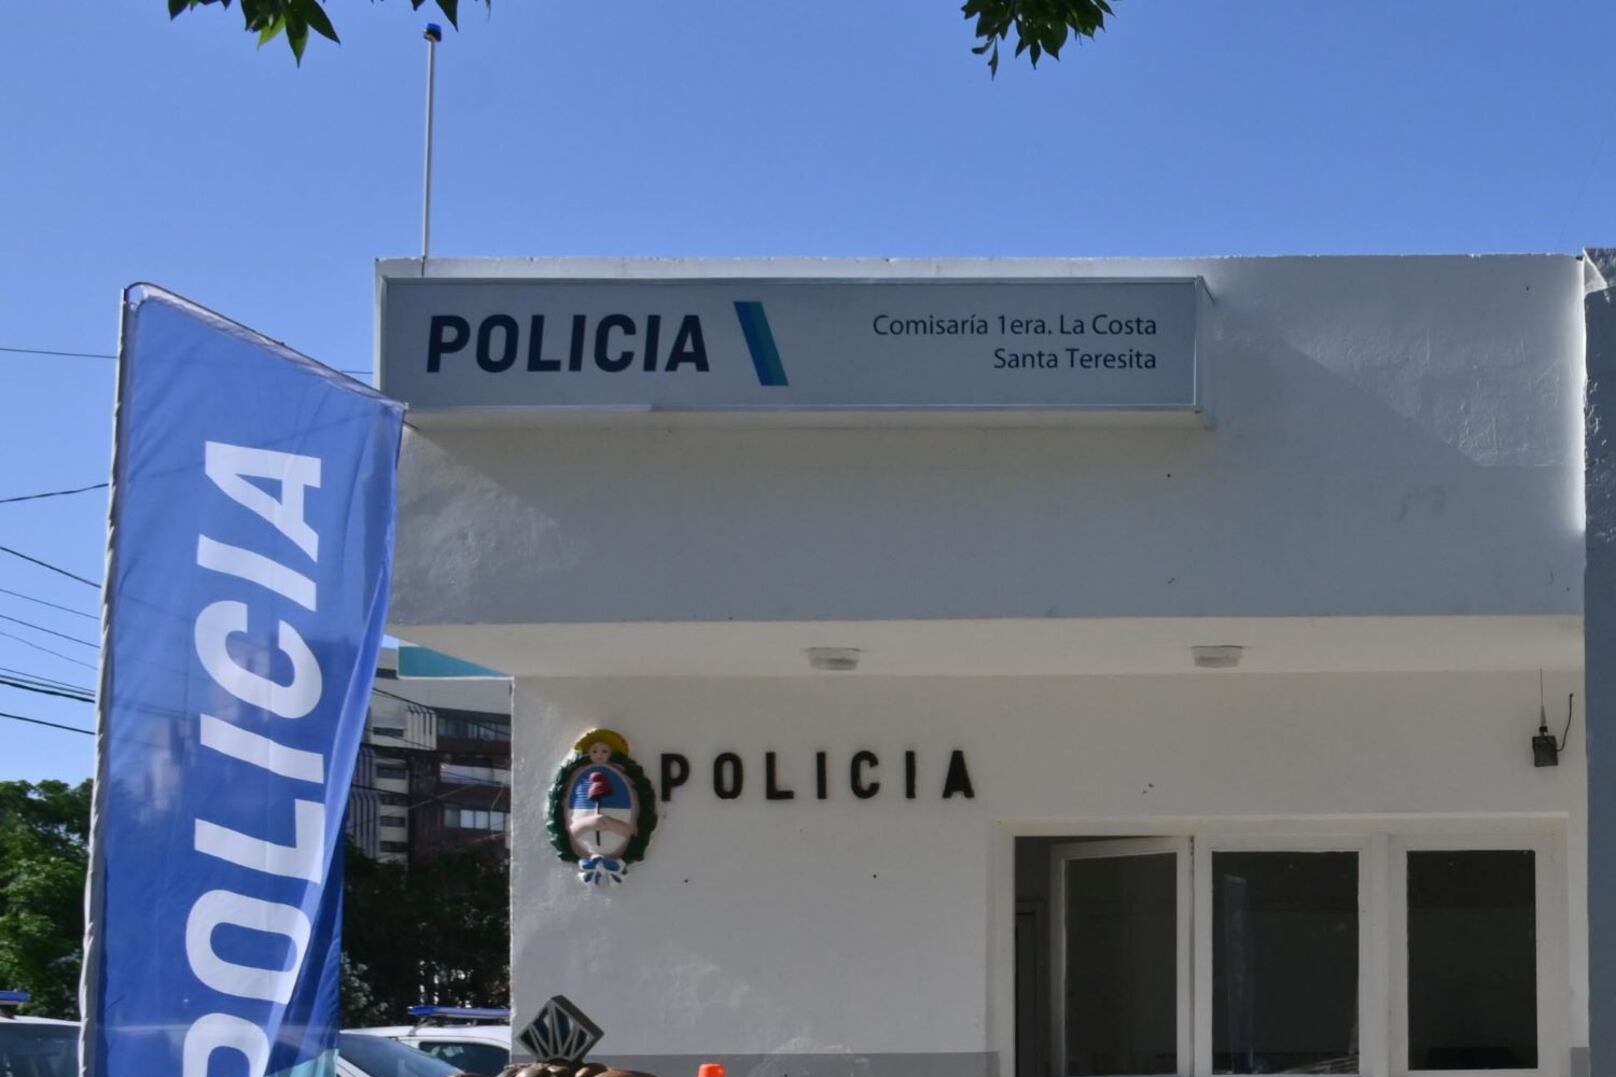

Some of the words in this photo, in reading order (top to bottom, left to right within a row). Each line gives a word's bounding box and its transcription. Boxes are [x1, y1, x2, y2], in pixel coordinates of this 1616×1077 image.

[426, 313, 710, 374] POLICIA
[873, 314, 988, 336] Comisaría
[997, 314, 1052, 336] 1era.
[1059, 314, 1085, 335] La
[1092, 314, 1157, 336] Costa
[993, 348, 1059, 369] Santa
[1065, 348, 1157, 369] Teresita
[660, 749, 975, 802] POLICIA
